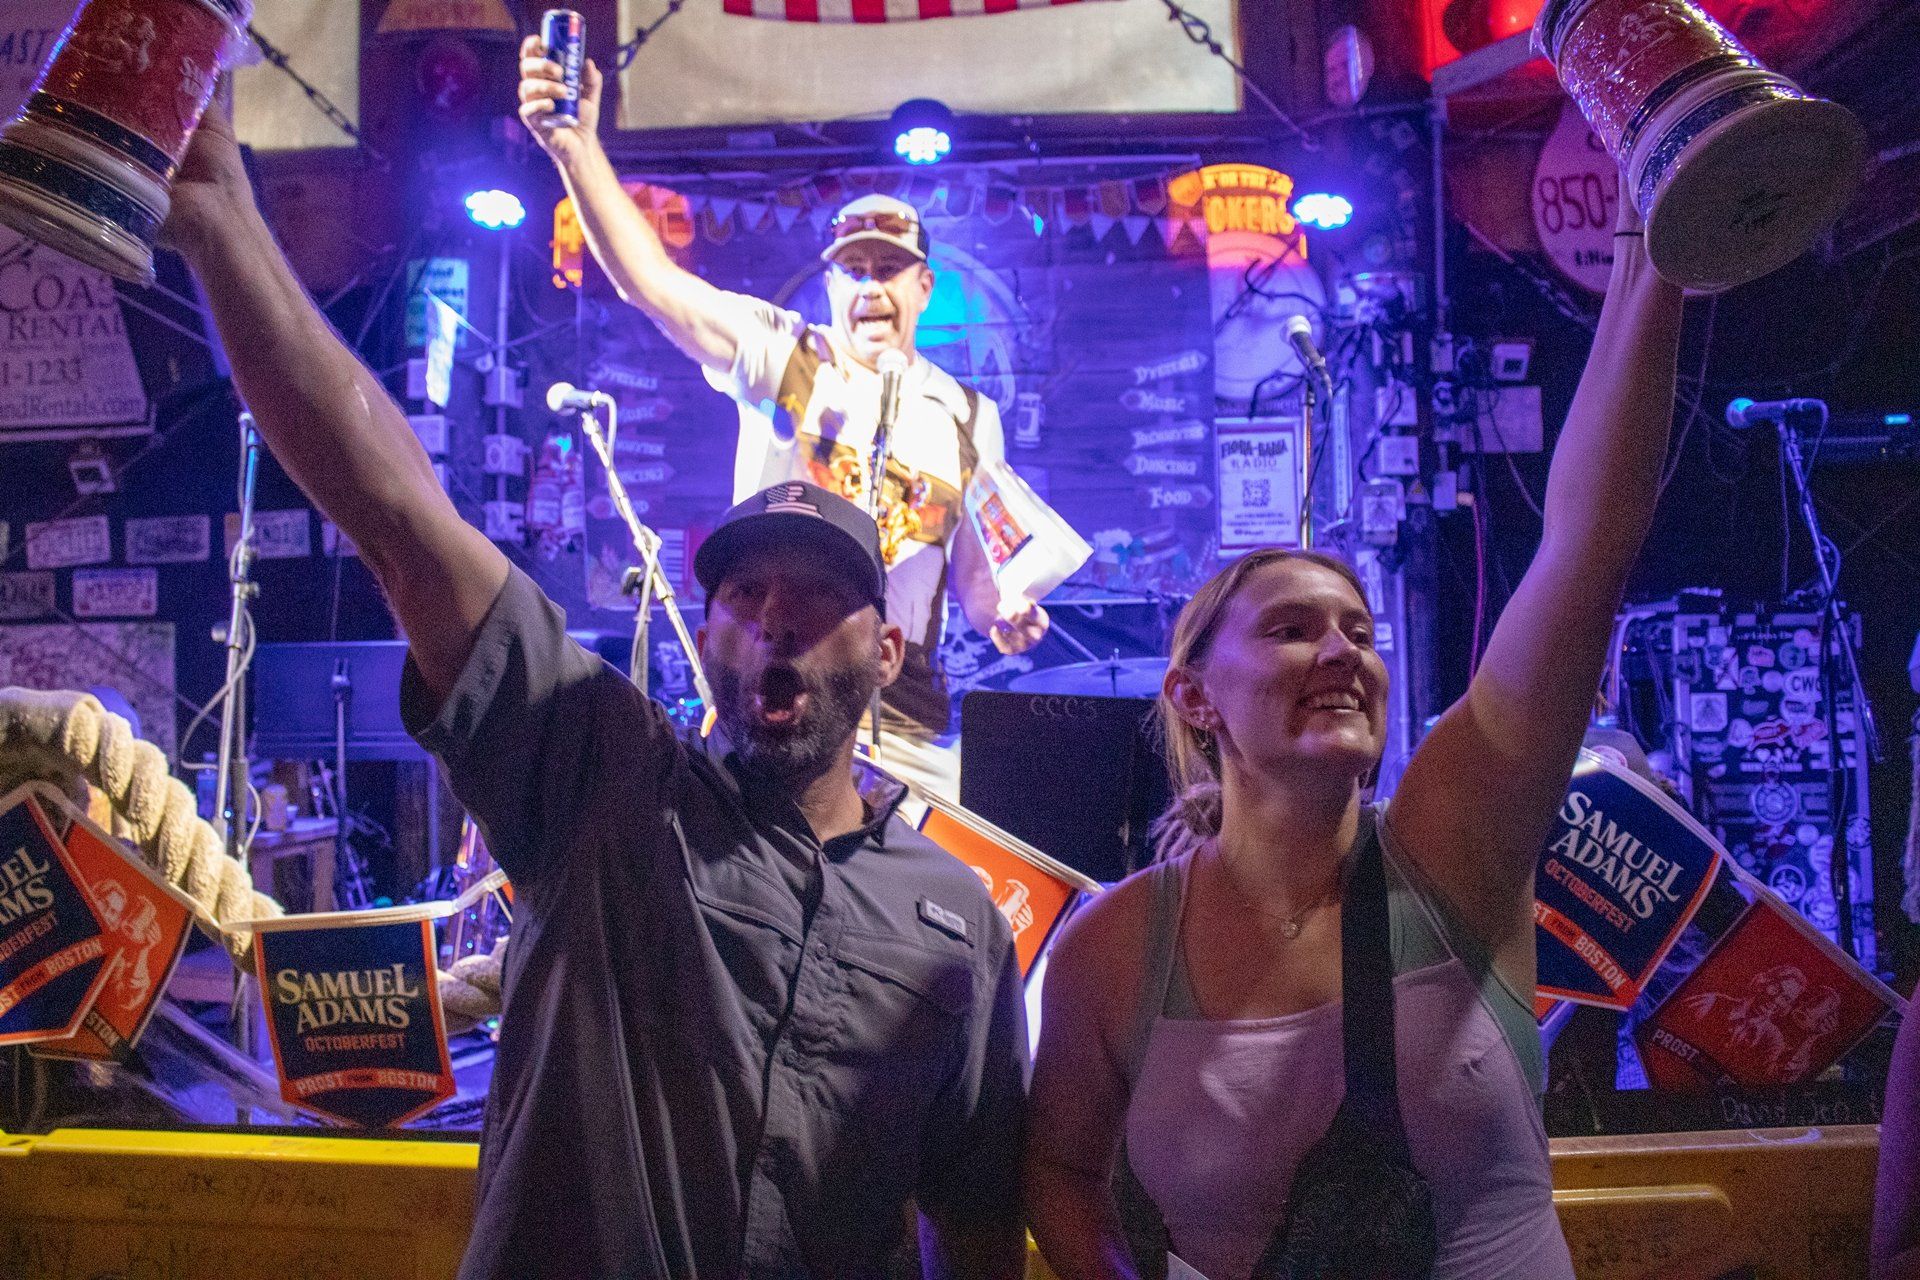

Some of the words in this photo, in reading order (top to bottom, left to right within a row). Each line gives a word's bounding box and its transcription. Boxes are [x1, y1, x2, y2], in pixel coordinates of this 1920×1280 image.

[1538, 172, 1619, 234] 850-
[1559, 791, 1684, 902] SAMUEL
[1549, 828, 1663, 918] ADAMS
[1545, 858, 1637, 933] OCTOBERFEST
[45, 937, 104, 976] BOSTON
[1574, 936, 1627, 989] BOSTON
[276, 963, 418, 1004] SAMUEL
[297, 998, 410, 1034] ADAMS
[305, 1032, 405, 1051] OCTOBERFEST
[1652, 1028, 1700, 1062] PROST
[296, 1073, 344, 1095] PROST
[377, 1071, 437, 1089] BOSTON
